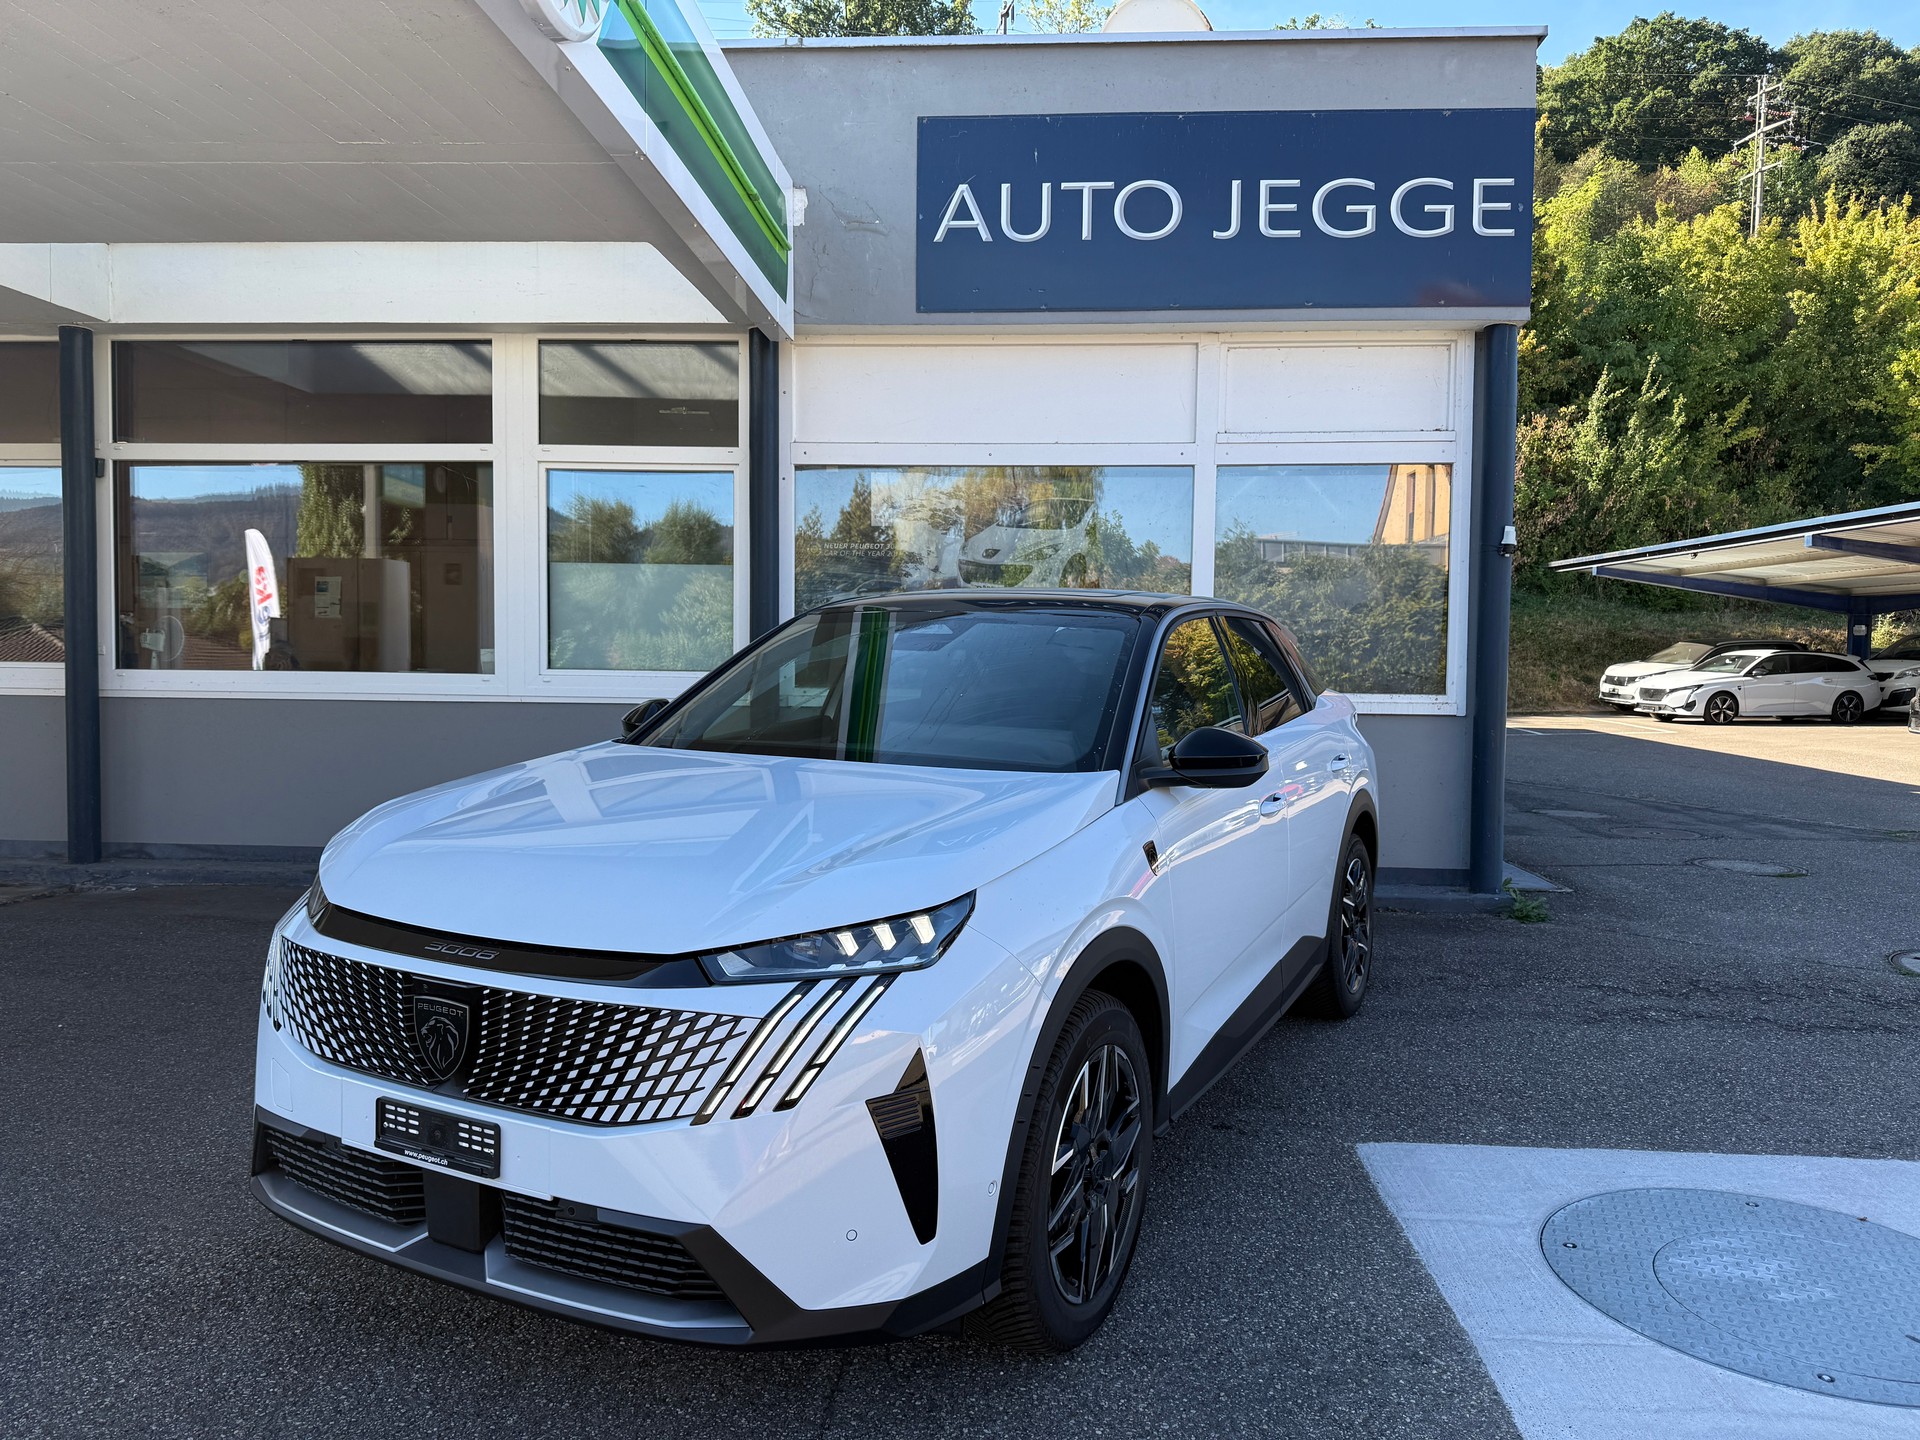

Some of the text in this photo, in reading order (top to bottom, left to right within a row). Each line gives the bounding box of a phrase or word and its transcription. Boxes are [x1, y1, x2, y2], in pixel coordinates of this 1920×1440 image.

[933, 178, 1516, 242] AUTO JEGGE
[823, 542, 848, 550] NEUER
[424, 942, 500, 960] 3008
[418, 1002, 464, 1017] PEUGEOT
[404, 1149, 448, 1166] www.peugeot.ch
